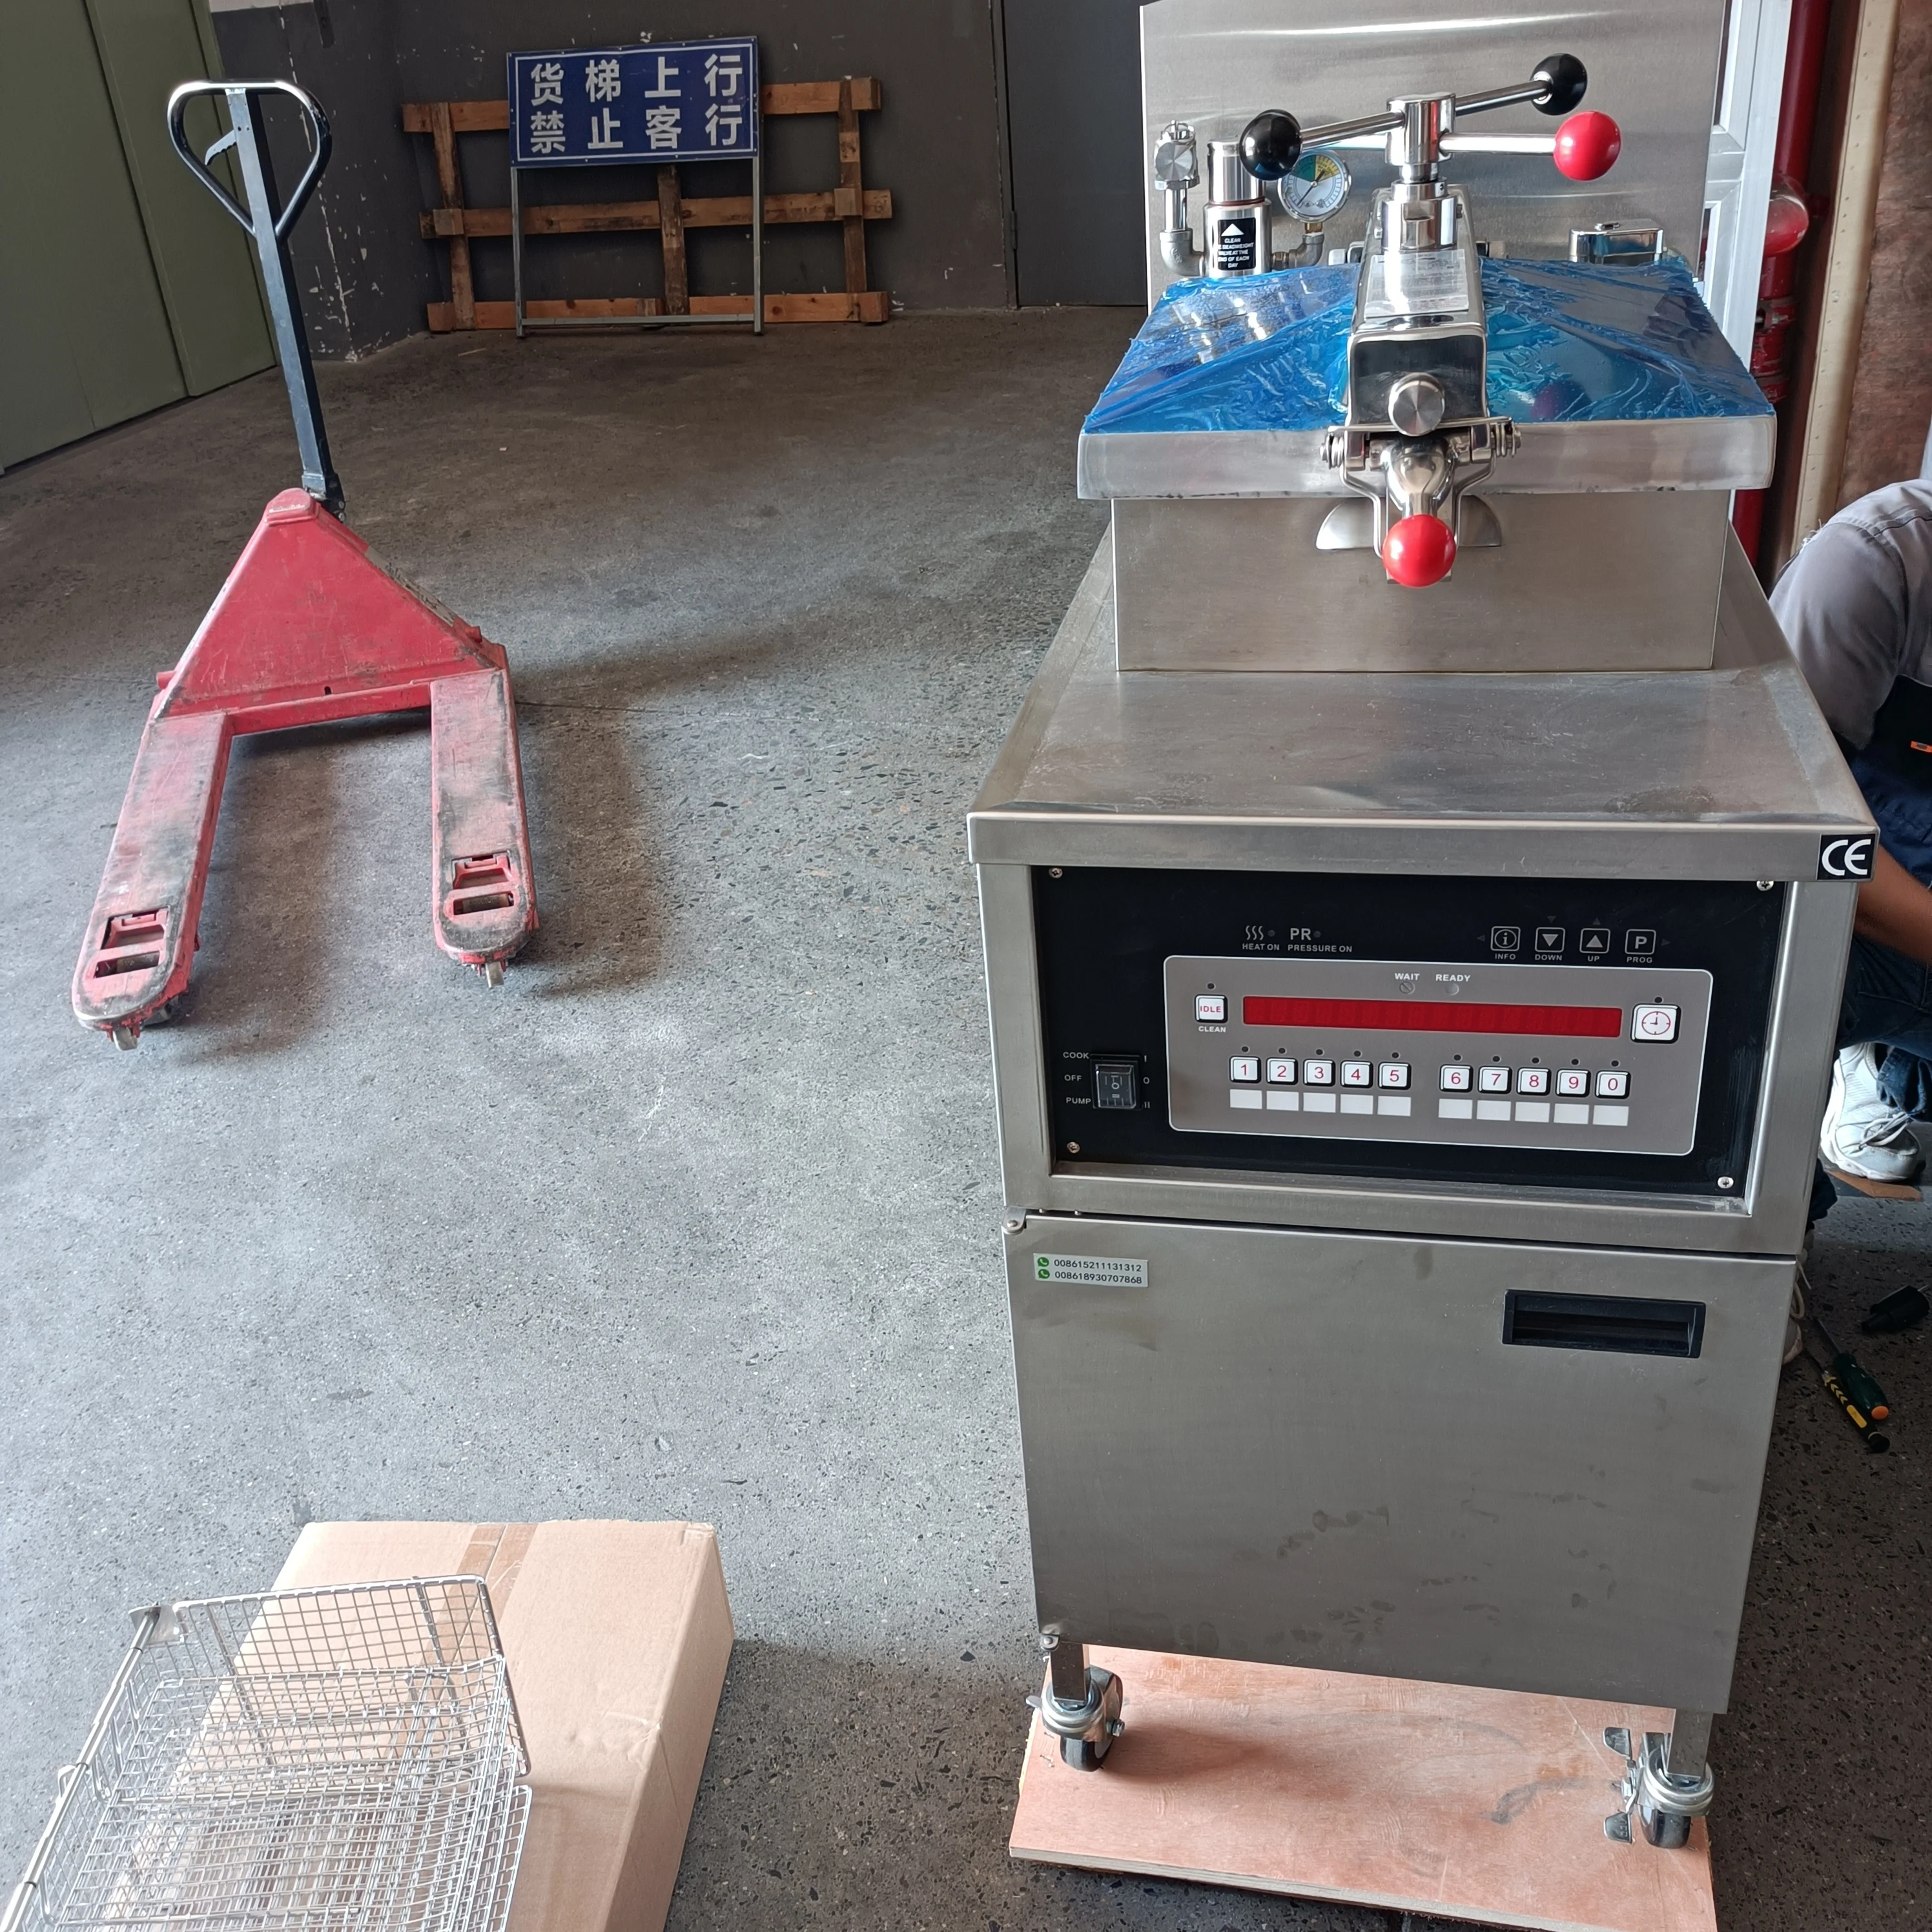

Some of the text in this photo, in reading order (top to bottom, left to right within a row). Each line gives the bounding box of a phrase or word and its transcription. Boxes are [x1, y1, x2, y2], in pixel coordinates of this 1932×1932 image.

[531, 54, 743, 107] 货梯上行
[530, 103, 743, 154] 禁止客行
[1822, 839, 1871, 876] CE
[1290, 927, 1311, 941] PR
[1288, 944, 1337, 952] PRESSURE
[1634, 936, 1648, 949] P
[1394, 972, 1420, 981] WAIT
[1435, 974, 1471, 982] READY
[1240, 1064, 1618, 1091] 1 2 3 4 5 6 7 8 9 0
[1054, 1259, 1142, 1272] 008615211131312
[1054, 1271, 1142, 1284] 008618930707868
